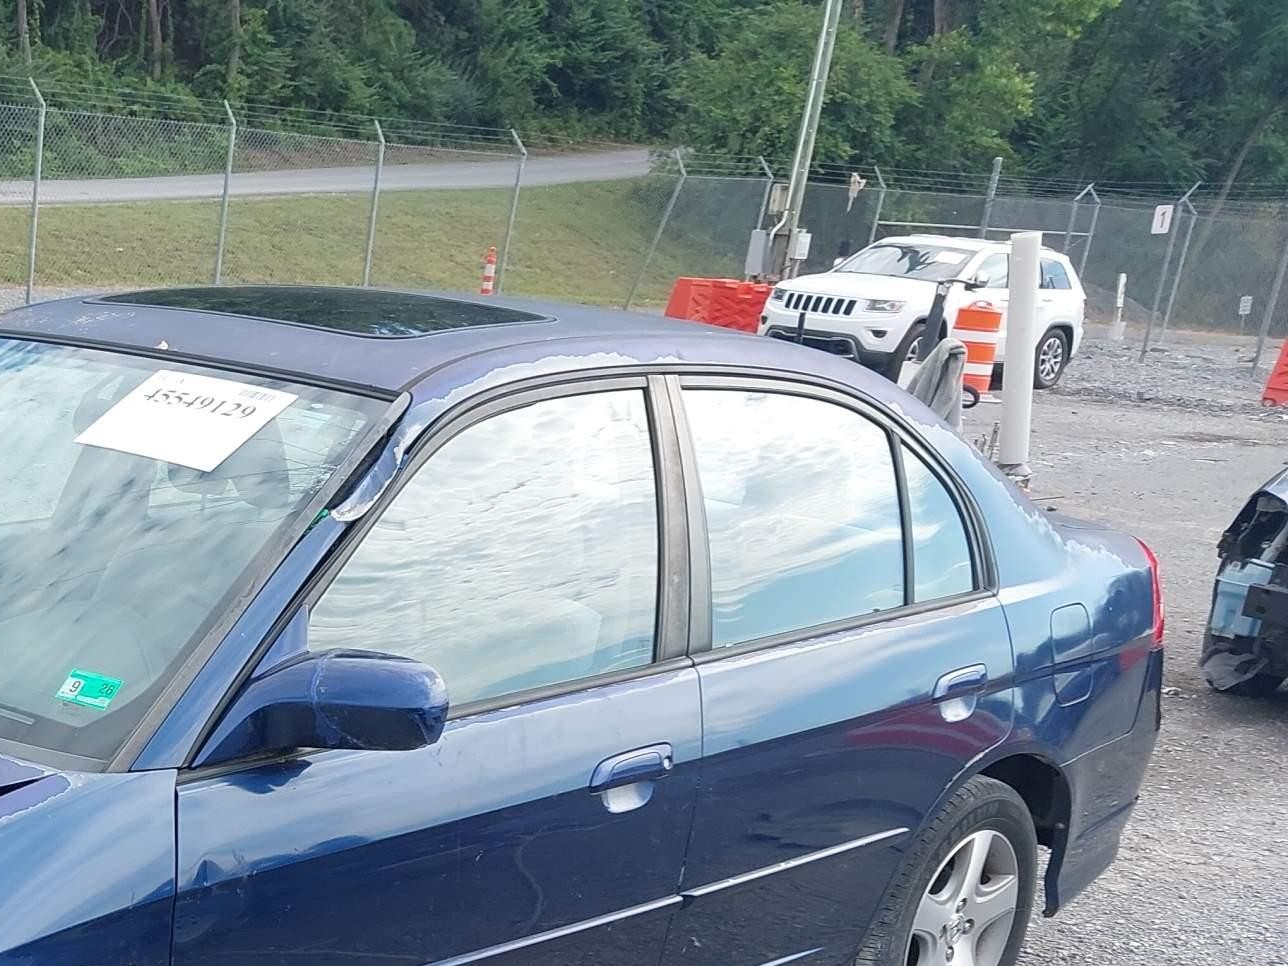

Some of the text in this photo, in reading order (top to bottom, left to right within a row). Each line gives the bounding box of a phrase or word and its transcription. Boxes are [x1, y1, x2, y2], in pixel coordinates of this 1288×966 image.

[1159, 210, 1167, 229] 1
[143, 388, 257, 419] 45549129
[69, 680, 81, 693] 9
